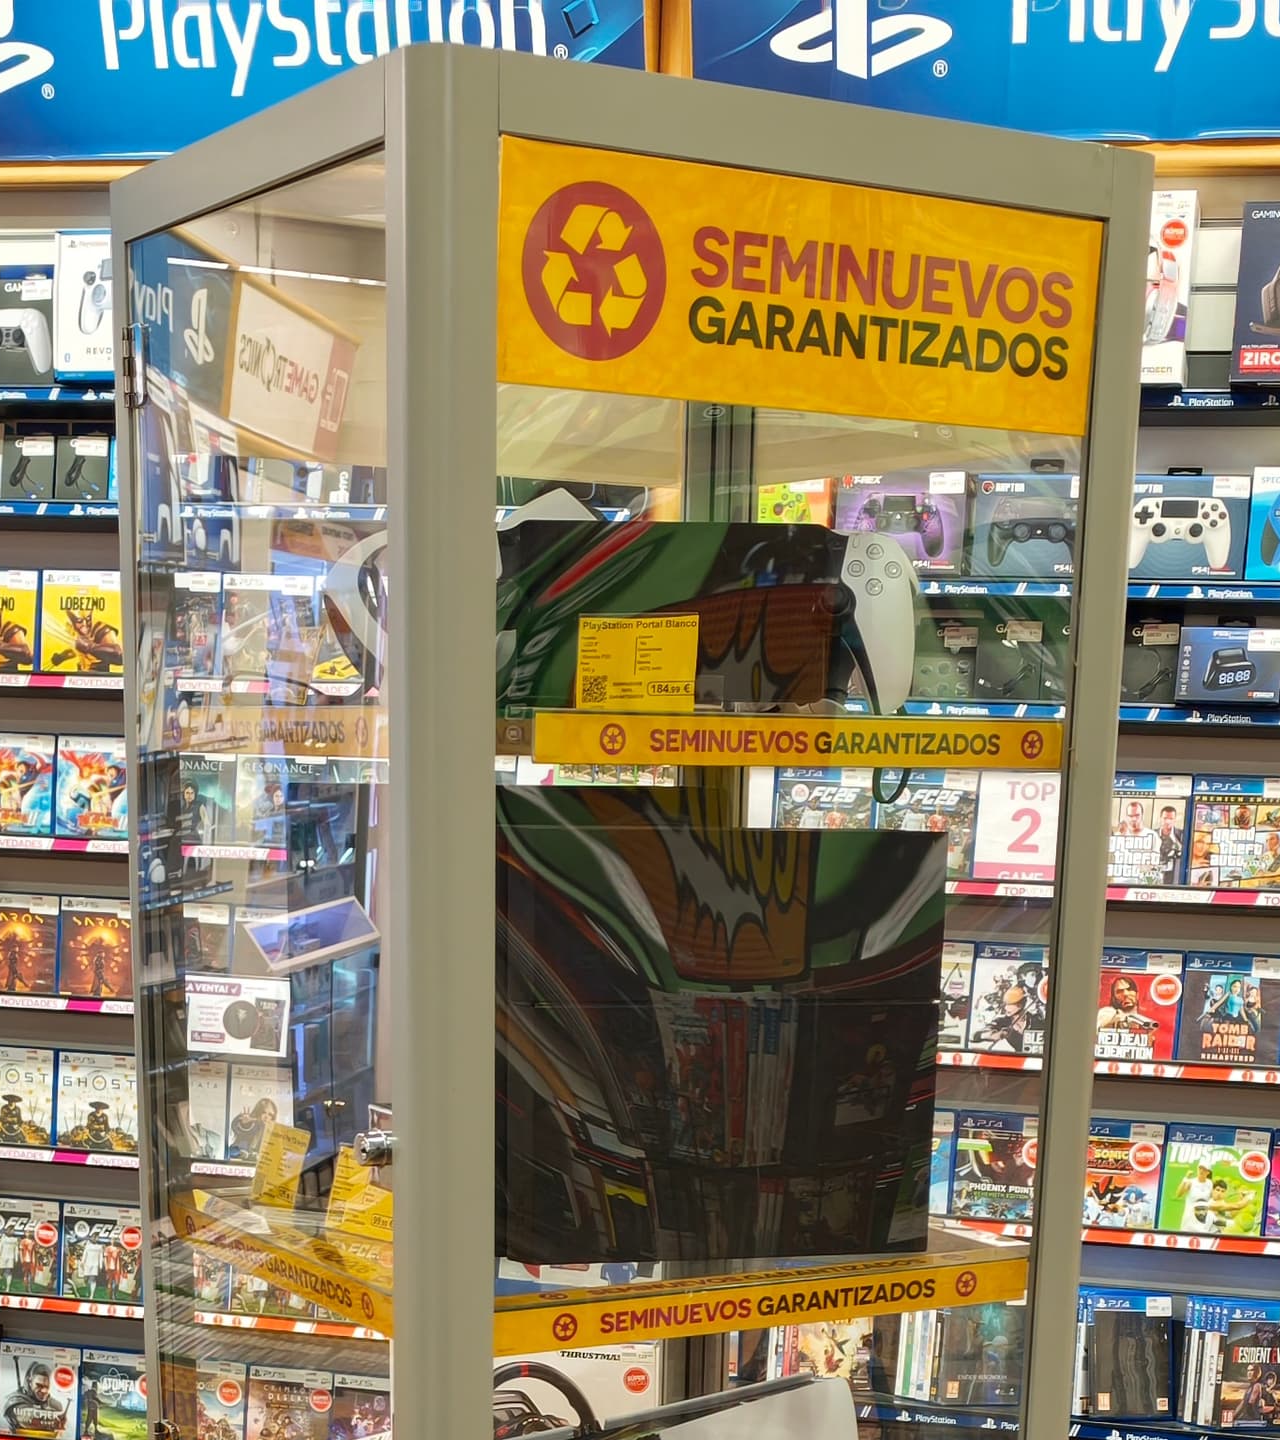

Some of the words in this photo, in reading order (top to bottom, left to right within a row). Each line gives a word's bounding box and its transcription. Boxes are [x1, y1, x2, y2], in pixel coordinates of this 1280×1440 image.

[691, 226, 1072, 329] SEMINUEVOS
[689, 295, 1067, 380] GARANTIZADOS
[1189, 397, 1234, 407] PlayStation
[60, 595, 105, 611] LOBEZNO
[583, 621, 633, 632] PlayStation
[636, 620, 663, 629] Portal
[665, 620, 698, 629] Blanco
[650, 730, 808, 754] SEMINUEVOS
[815, 732, 1000, 756] GARANTIZADOS
[1007, 781, 1056, 801] TOP
[1007, 808, 1040, 853] 2
[1213, 1023, 1248, 1036] TOMB
[1201, 1034, 1256, 1051] RAIDER
[600, 1298, 751, 1334] SEMINUEVOS
[757, 1278, 936, 1317] GARANTIZADOS
